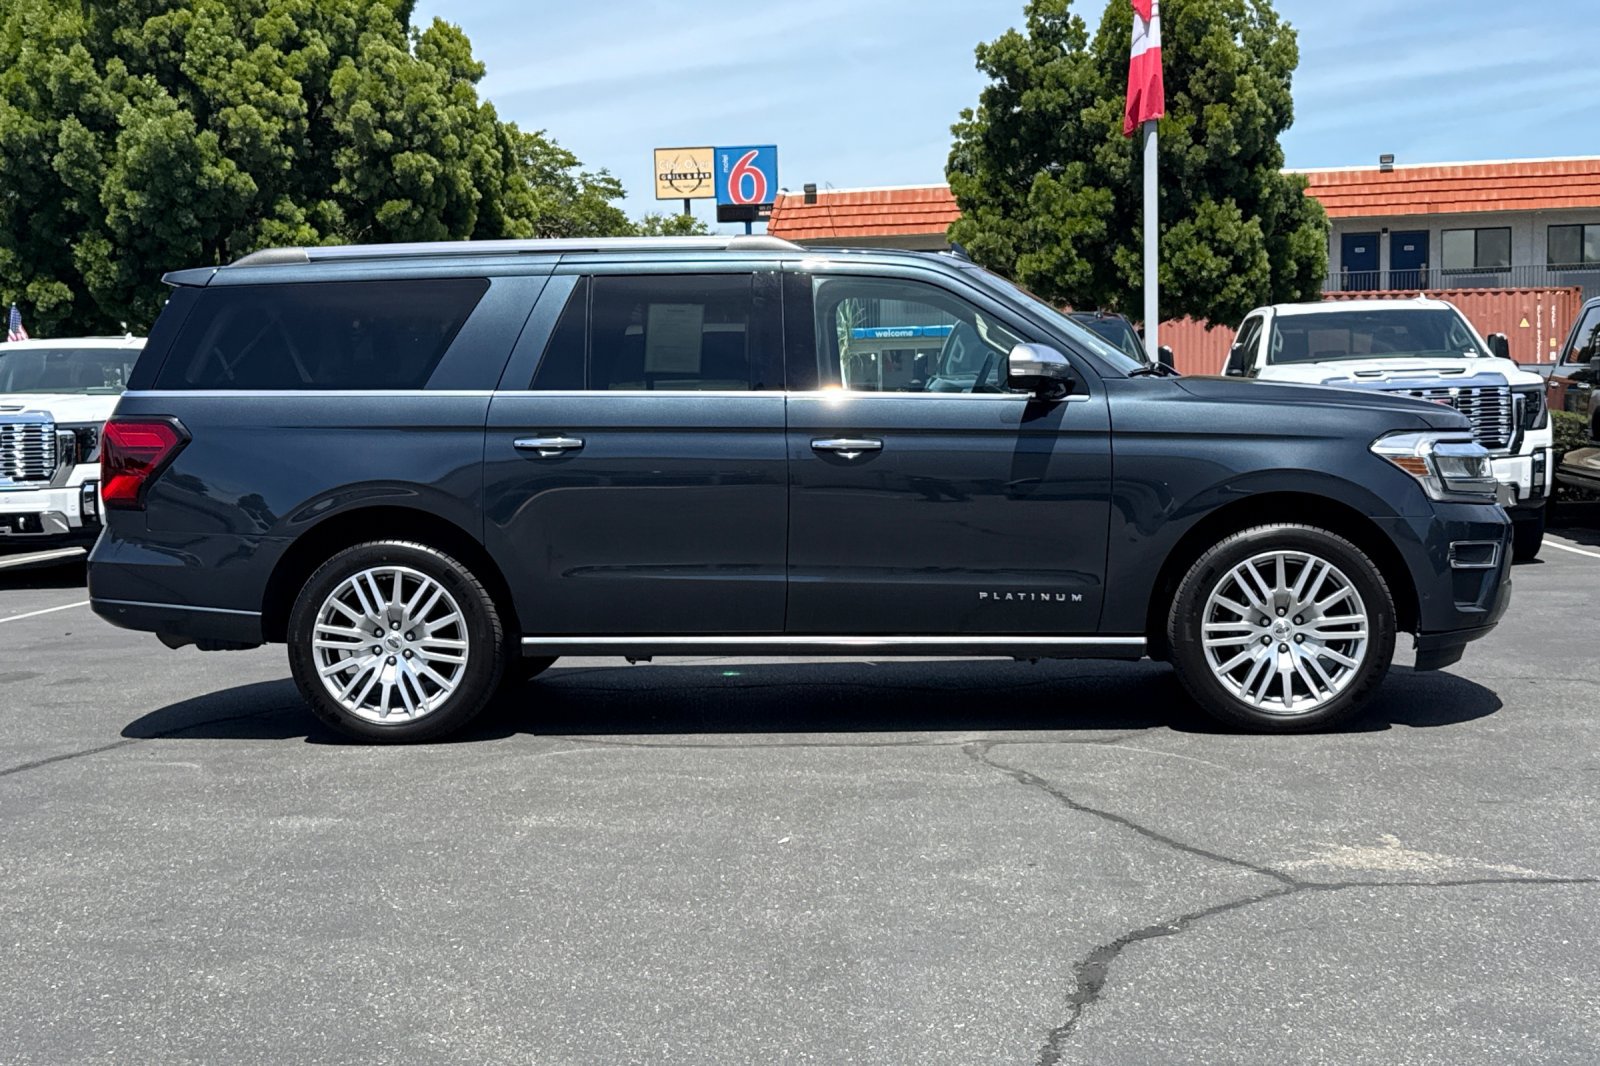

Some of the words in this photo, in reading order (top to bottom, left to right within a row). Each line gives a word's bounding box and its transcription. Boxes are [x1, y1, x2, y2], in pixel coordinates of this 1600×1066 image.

[721, 154, 729, 173] motel
[728, 149, 767, 205] 6
[875, 329, 914, 338] welcome
[979, 591, 1083, 602] PLATINUM
